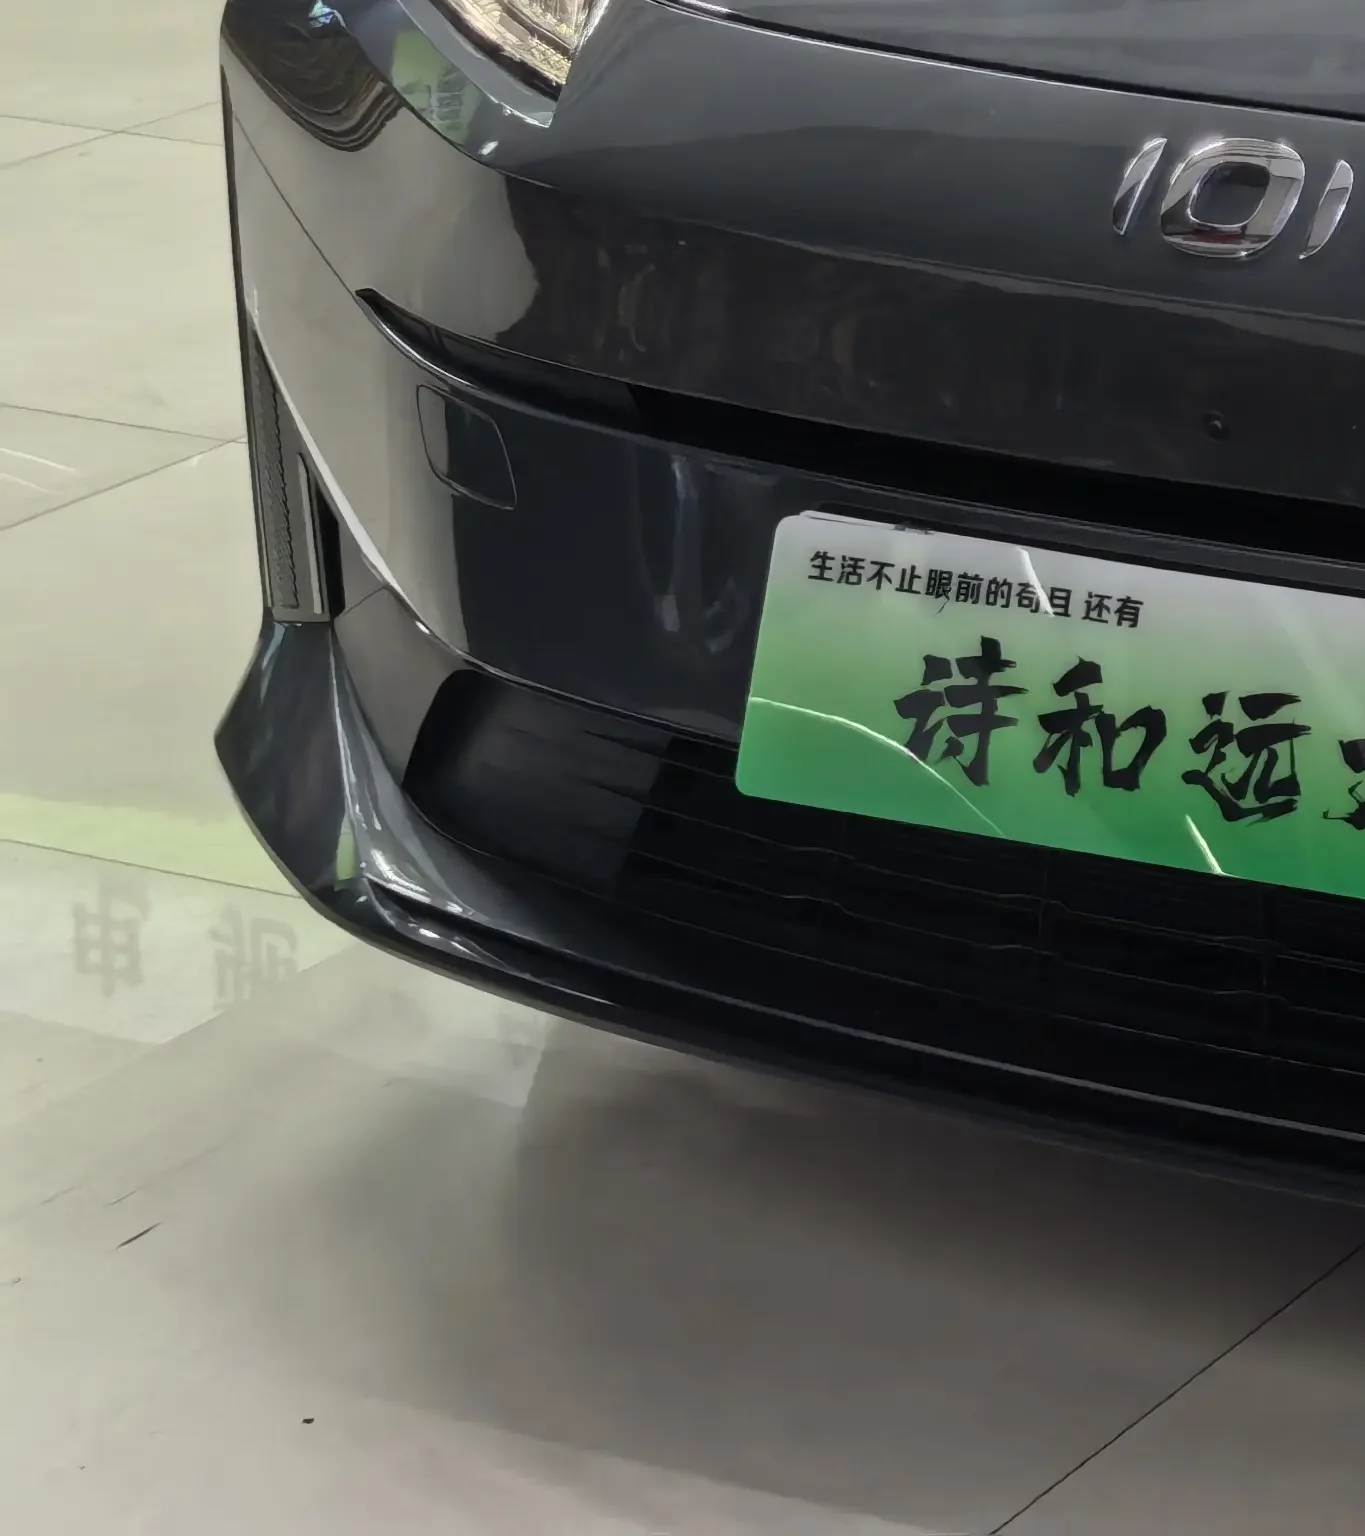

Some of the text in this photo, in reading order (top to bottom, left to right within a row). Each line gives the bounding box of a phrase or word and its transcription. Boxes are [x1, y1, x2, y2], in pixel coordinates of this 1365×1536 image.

[808, 550, 1145, 629] 生活不止眼前的苟且 还有
